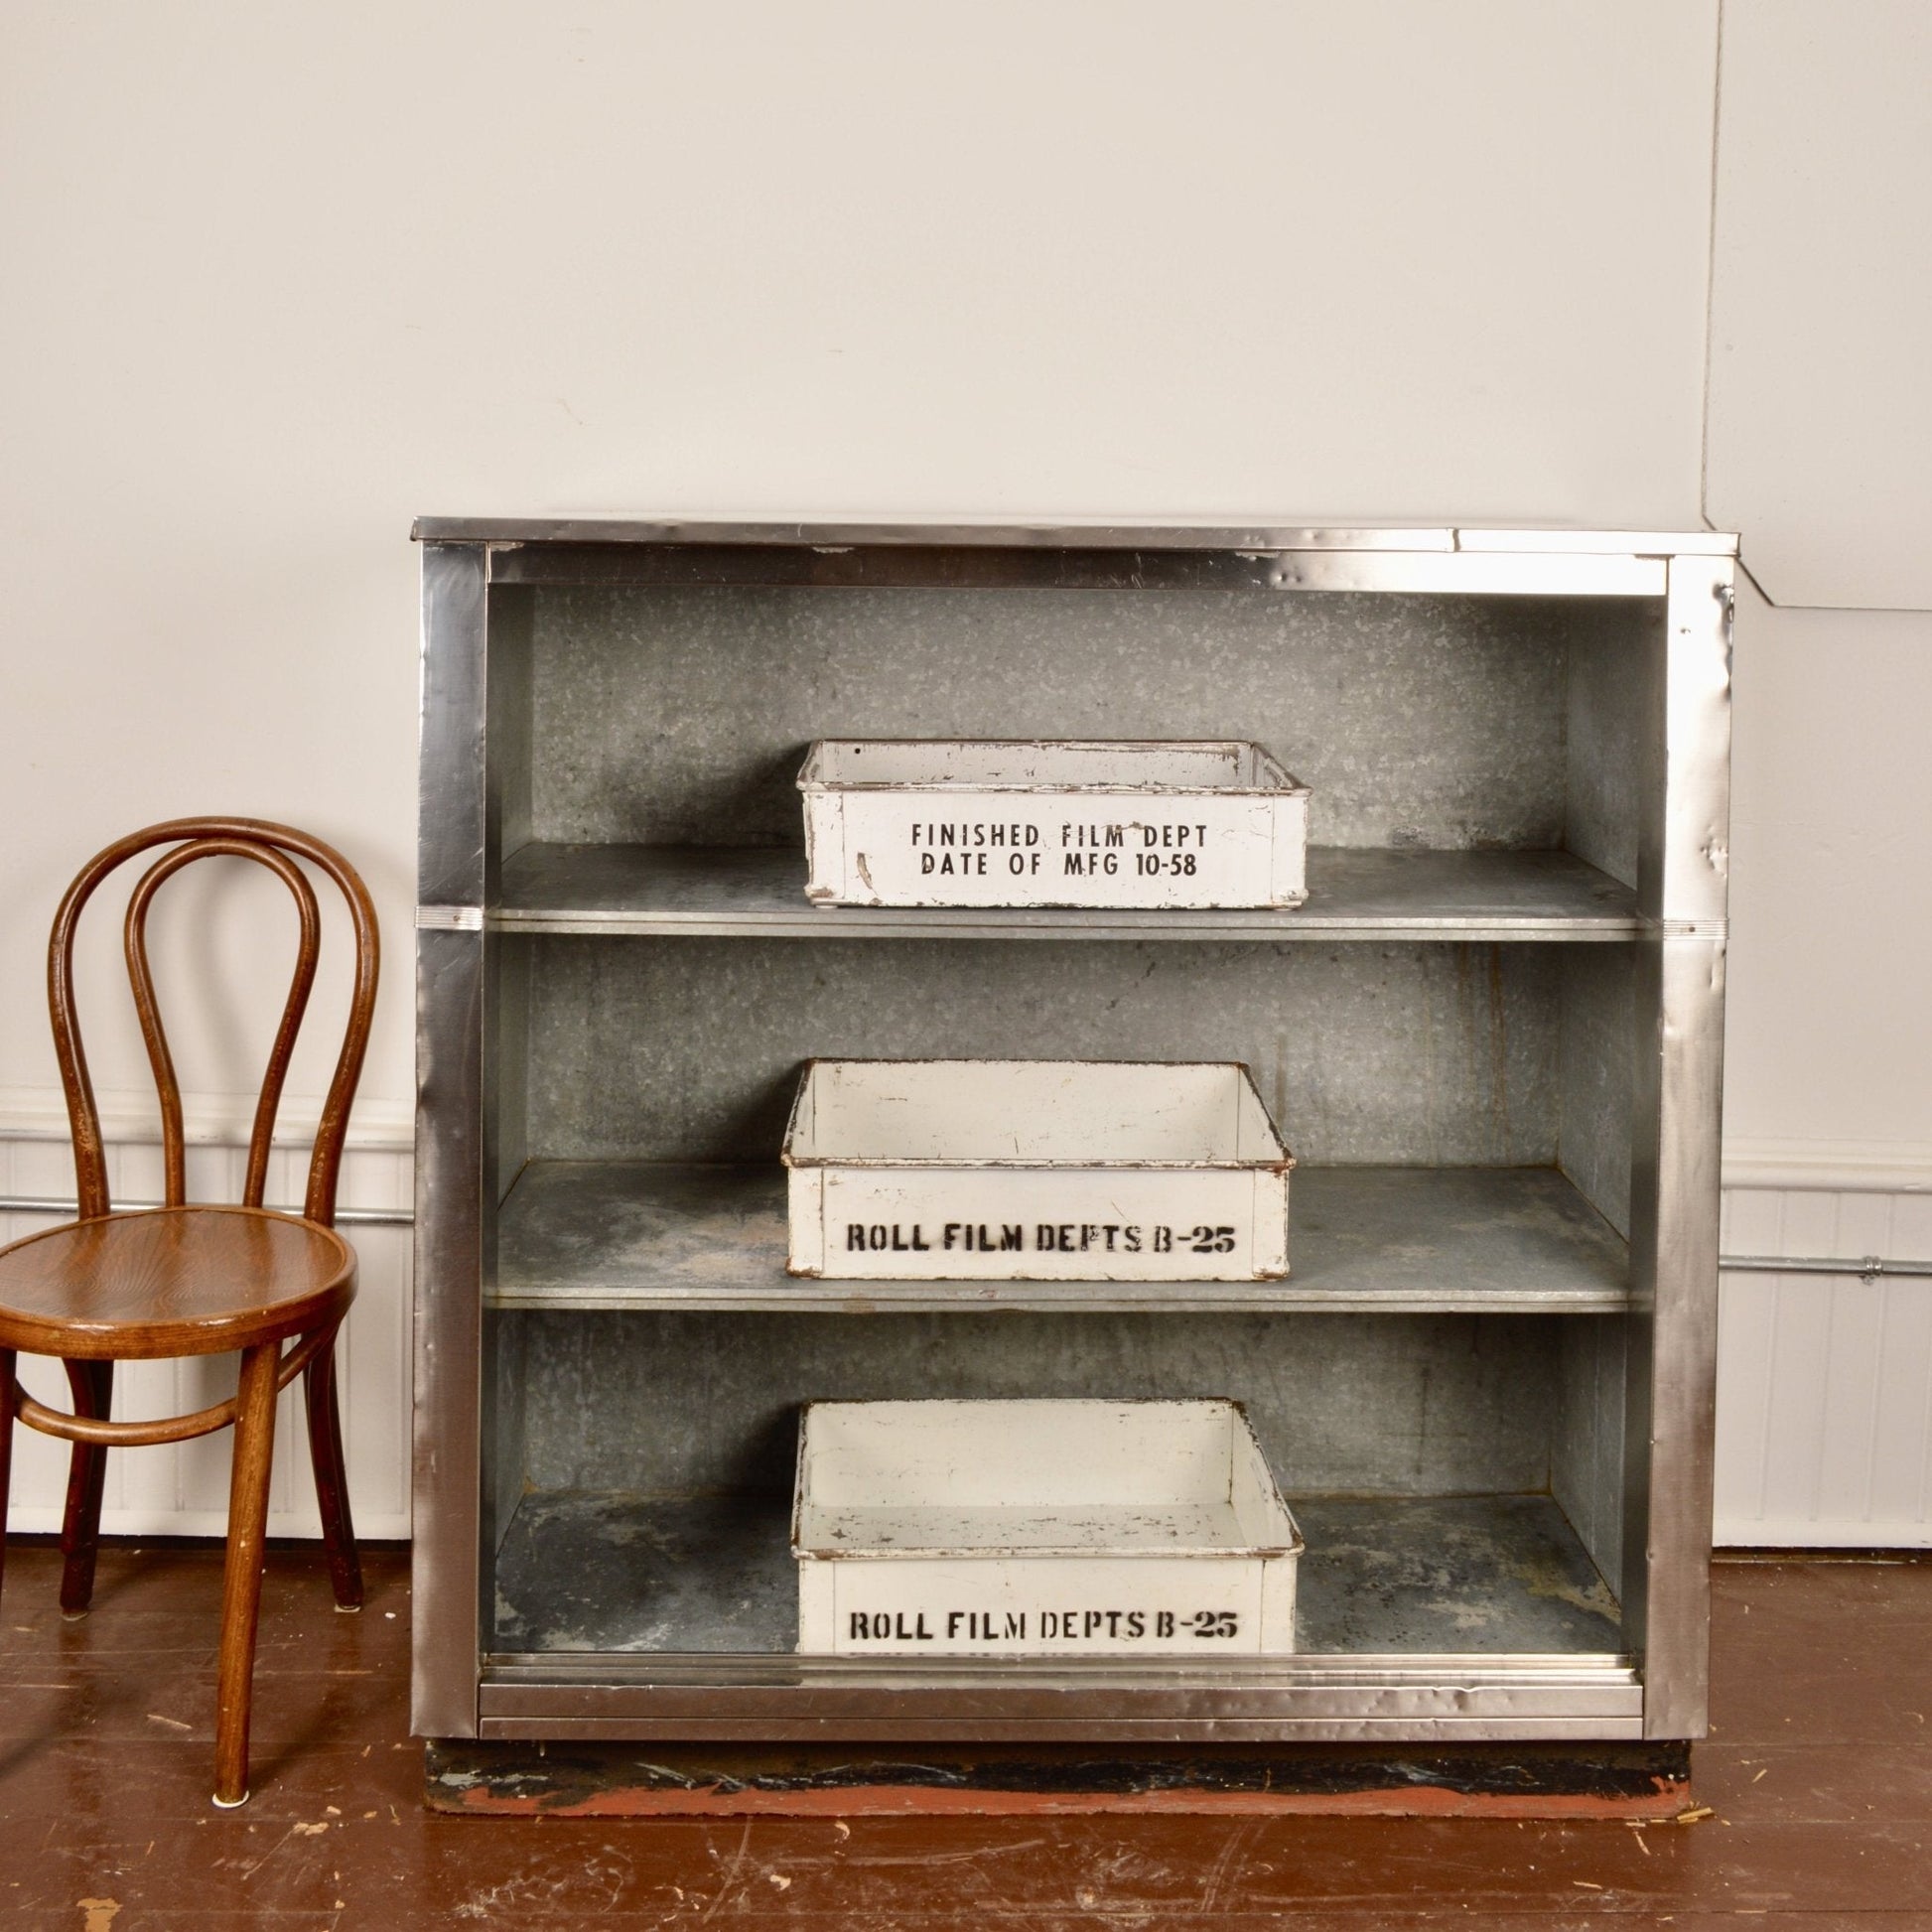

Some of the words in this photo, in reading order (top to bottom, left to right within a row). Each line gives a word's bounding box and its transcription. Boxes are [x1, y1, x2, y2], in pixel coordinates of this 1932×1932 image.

[911, 823, 1039, 847] FINISHED
[1061, 824, 1125, 848] FILM
[1144, 824, 1207, 848] DEPT
[921, 852, 988, 876] DATE
[1009, 853, 1041, 876] OF
[1063, 853, 1119, 876] MFG
[1136, 853, 1197, 877] 10-58
[847, 1223, 930, 1251] ROLL
[943, 1223, 1023, 1251] FILM
[1036, 1224, 1142, 1252] DEPTS
[1153, 1225, 1236, 1253] B-25
[850, 1611, 933, 1639] ROLL
[947, 1611, 1026, 1639] FILM
[1040, 1611, 1145, 1639] DEPTS
[1156, 1611, 1238, 1639] B-25
